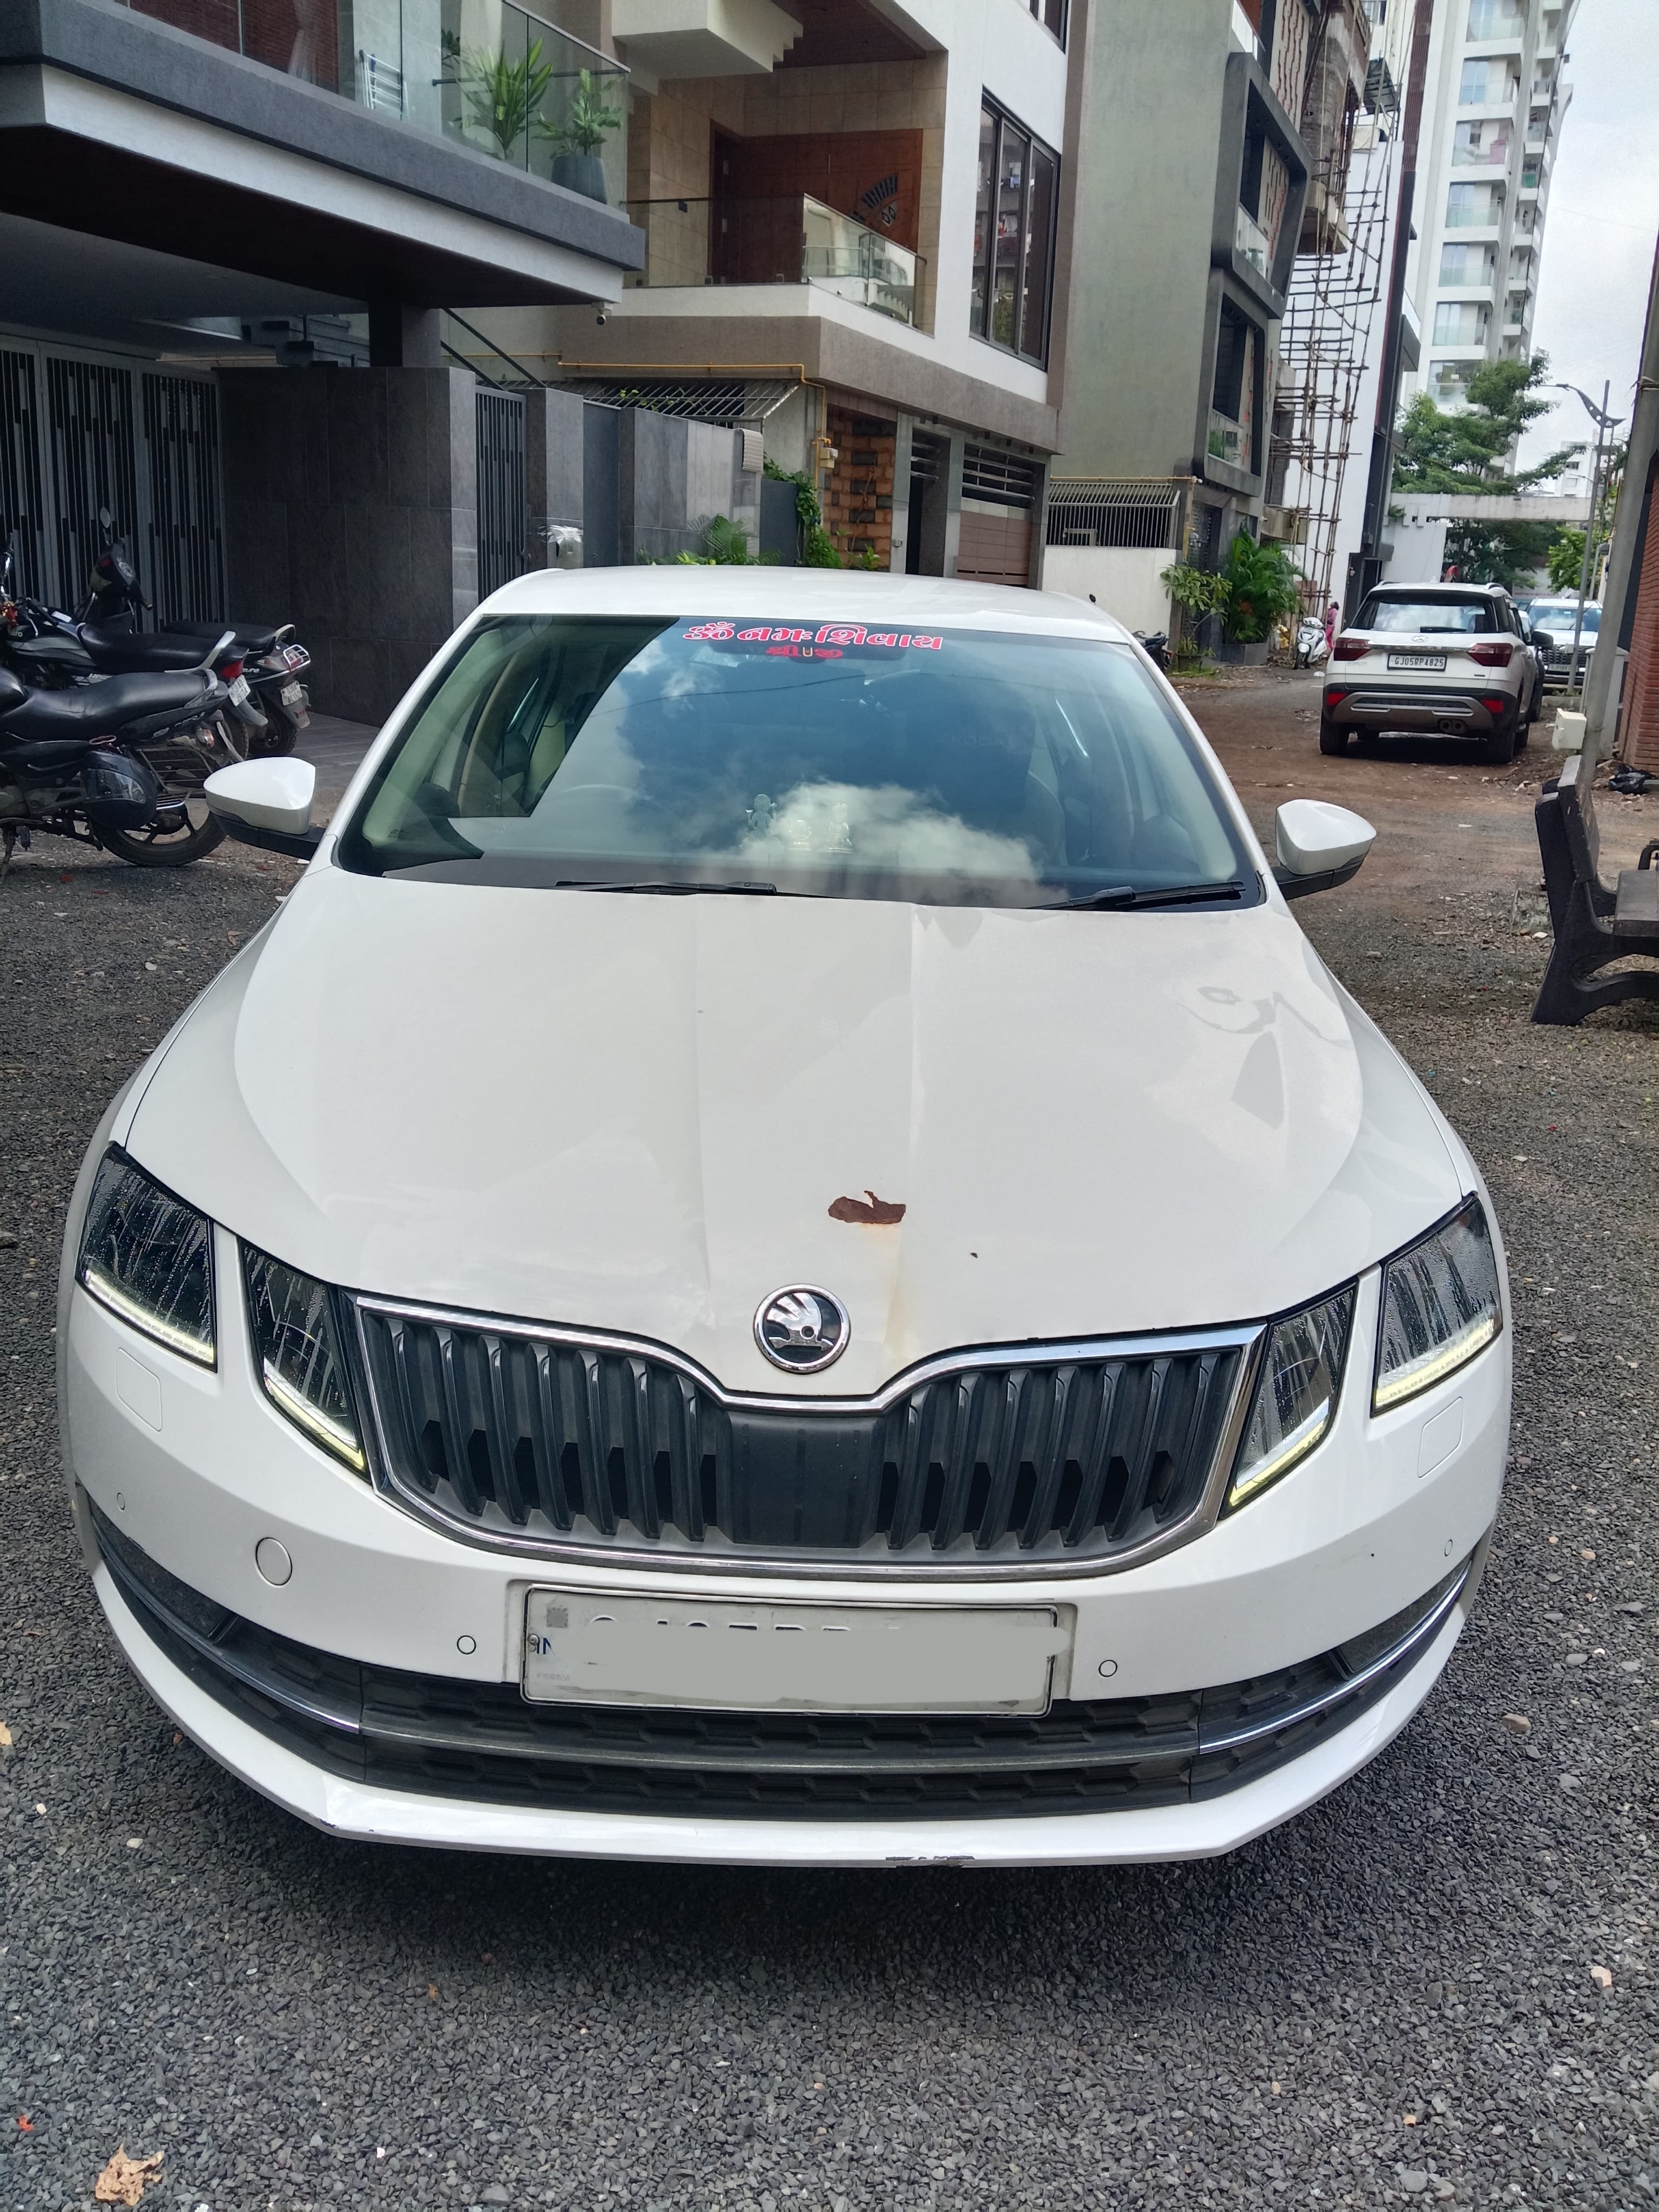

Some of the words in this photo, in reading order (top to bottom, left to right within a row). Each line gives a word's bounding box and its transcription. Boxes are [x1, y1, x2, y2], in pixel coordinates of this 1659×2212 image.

[814, 624, 944, 650] શિવાય
[1394, 657, 1444, 666] GJ05RP4825
[536, 1637, 556, 1655] IN
